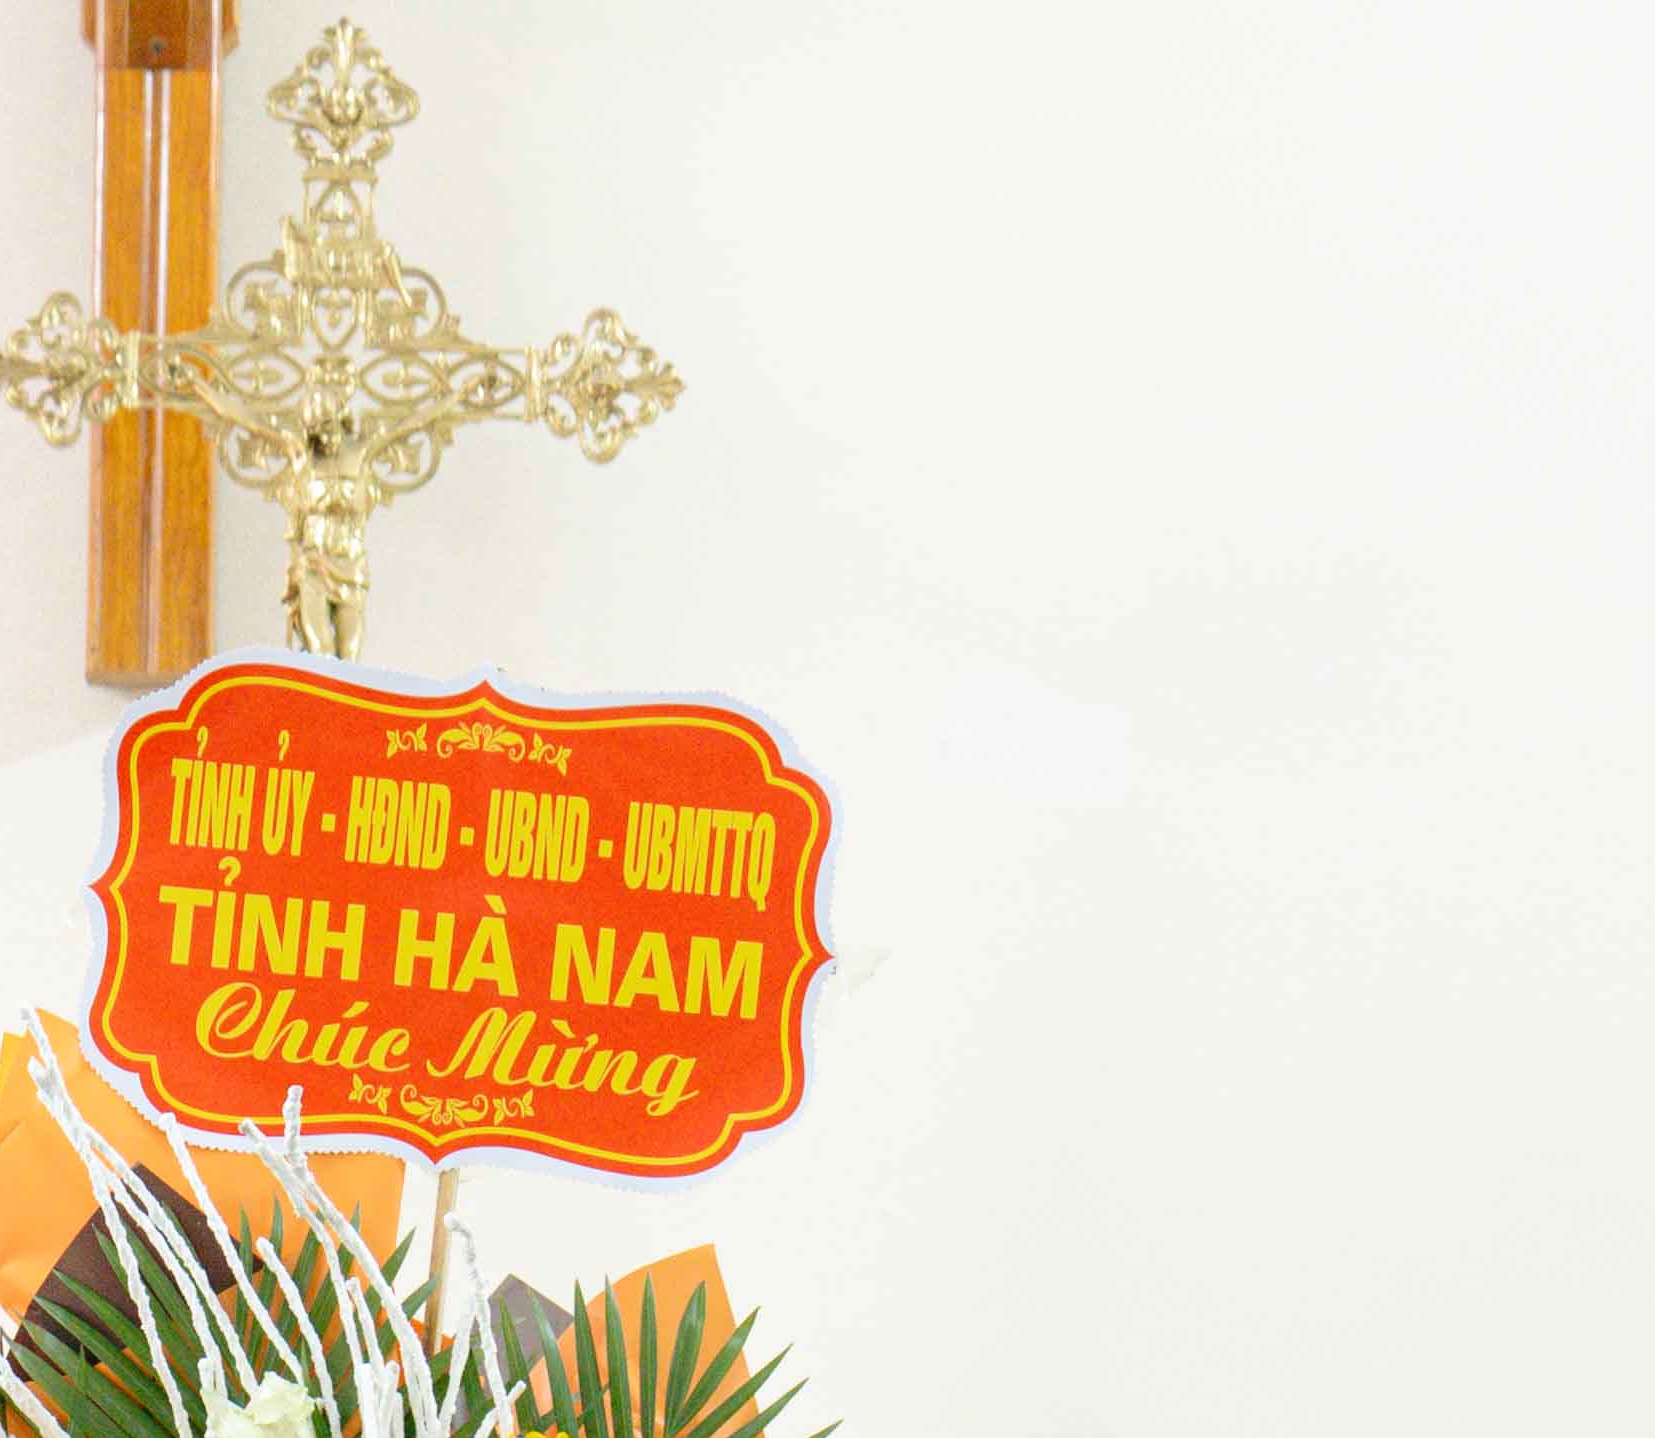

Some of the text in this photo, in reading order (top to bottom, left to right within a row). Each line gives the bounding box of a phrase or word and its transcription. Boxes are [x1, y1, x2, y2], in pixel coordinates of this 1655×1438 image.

[169, 725, 256, 851] TỈNH
[261, 729, 316, 857] ỦY
[344, 775, 452, 871] HĐND
[484, 788, 591, 884] UBND
[623, 801, 776, 912] UBMTTQ
[158, 855, 764, 1020] TỈNH HÀ NAM
[195, 980, 700, 1118] Chúc Mừng
